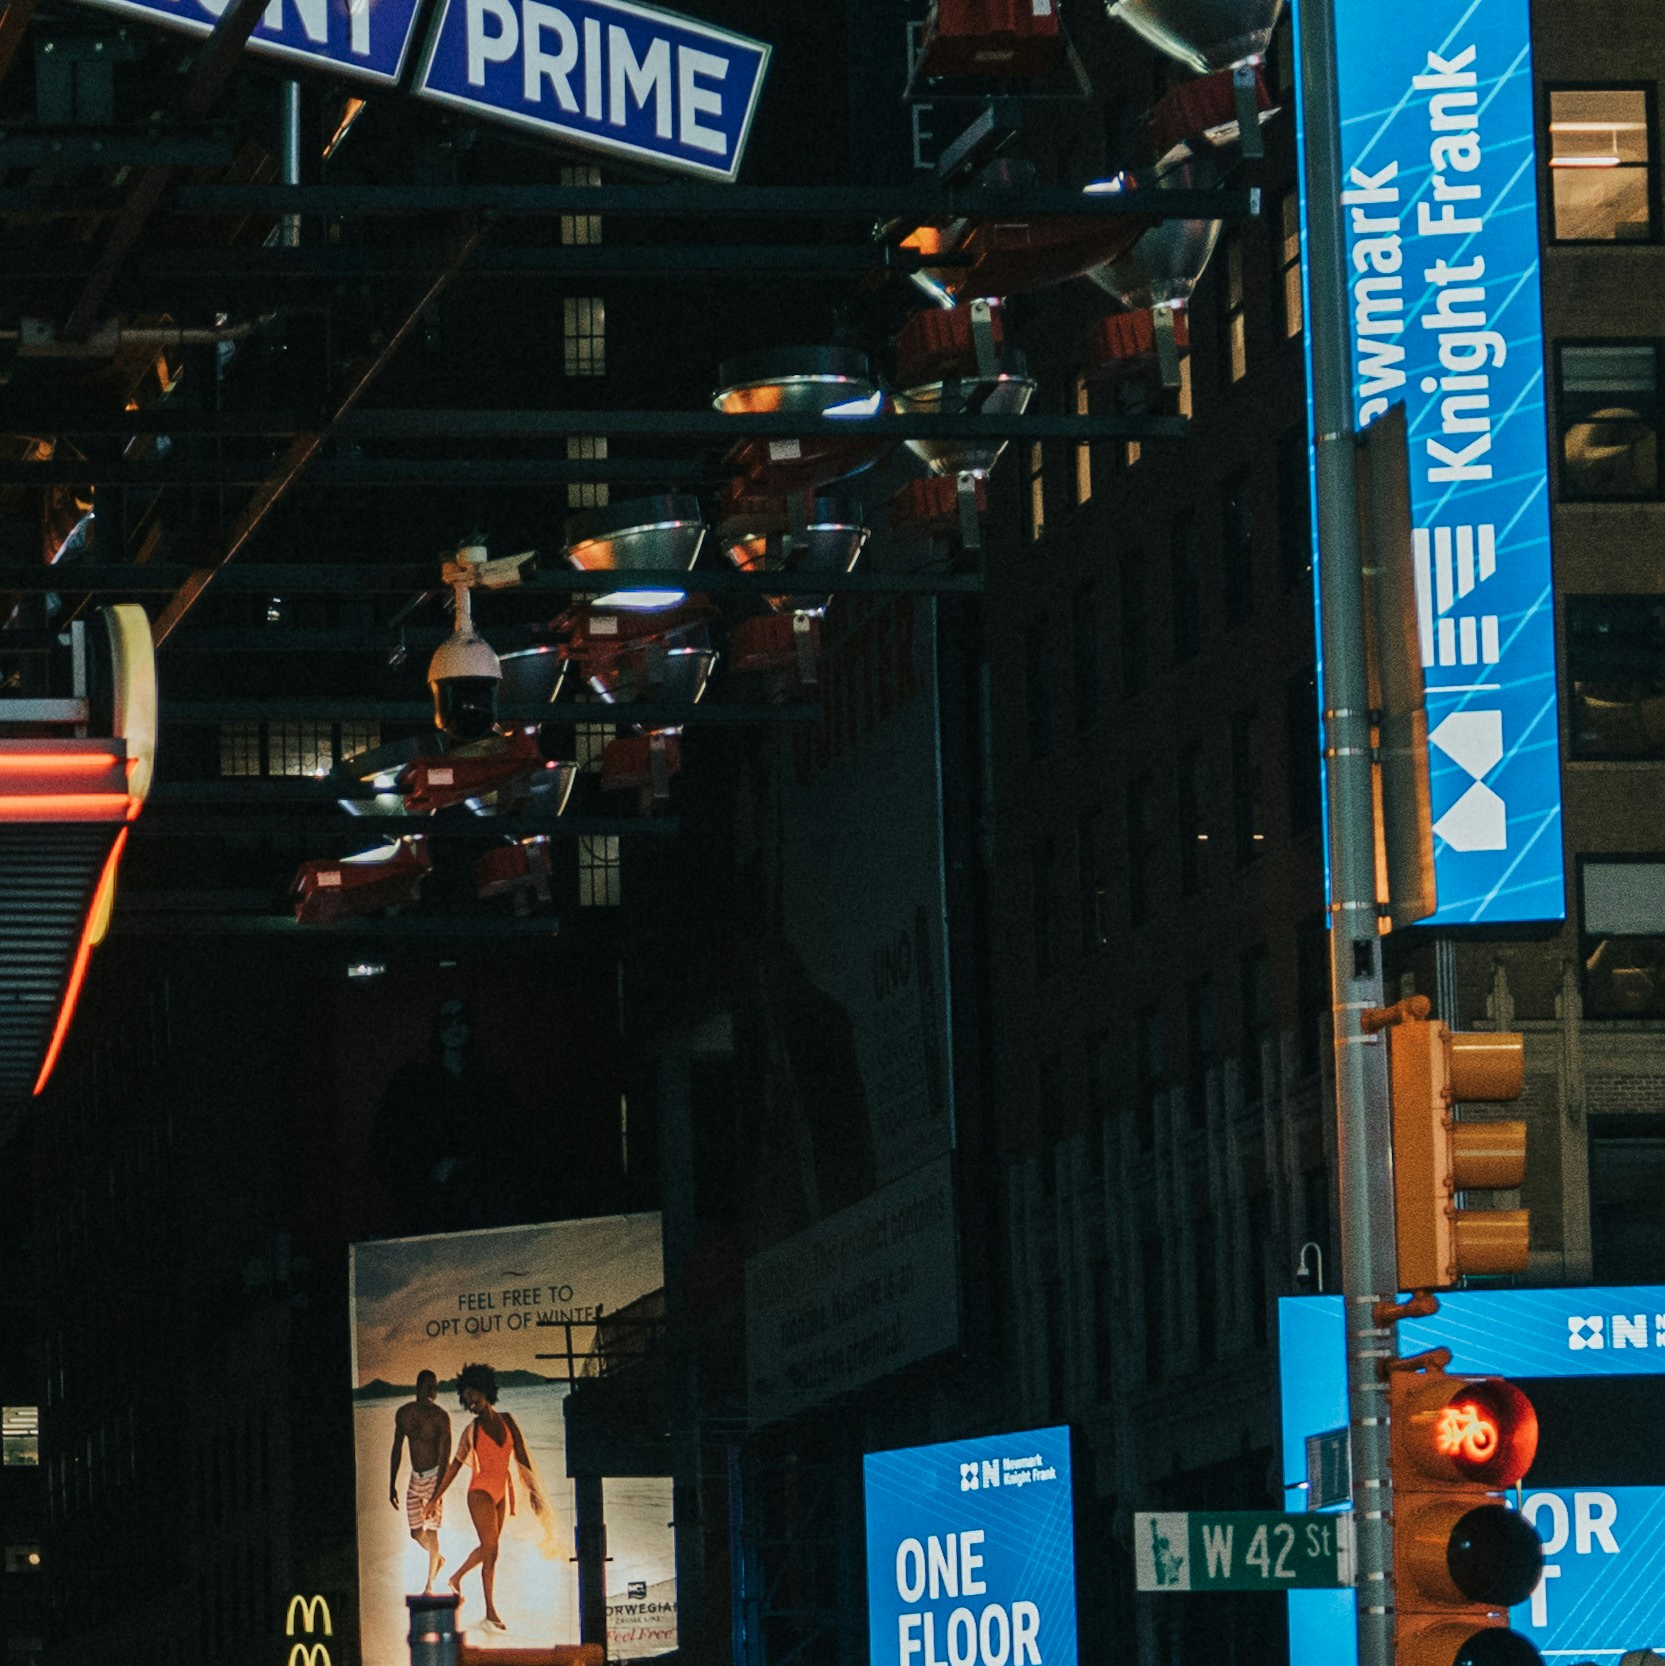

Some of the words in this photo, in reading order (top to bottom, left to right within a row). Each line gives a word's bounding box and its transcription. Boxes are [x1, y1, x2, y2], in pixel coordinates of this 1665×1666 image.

[467, 0, 729, 156] PRIME
[1412, 44, 1483, 236] Frank
[1340, 160, 1406, 431] wmark
[1420, 255, 1507, 482] Knight
[426, 1318, 461, 1337] OPT
[465, 1314, 502, 1334] OUT
[507, 1312, 532, 1331] OF
[537, 1306, 598, 1324] WINTE
[458, 1293, 496, 1311] FEEL
[503, 1288, 542, 1307] FREE
[548, 1285, 574, 1303] TO
[1003, 1454, 1043, 1472] Newmark
[1003, 1470, 1031, 1488] Knight
[1032, 1467, 1057, 1483] Frank
[896, 1530, 987, 1603] ONE
[1202, 1525, 1233, 1578] W
[1245, 1523, 1296, 1578] 42
[1306, 1523, 1331, 1557] St
[606, 1602, 677, 1616] ORWEGIA
